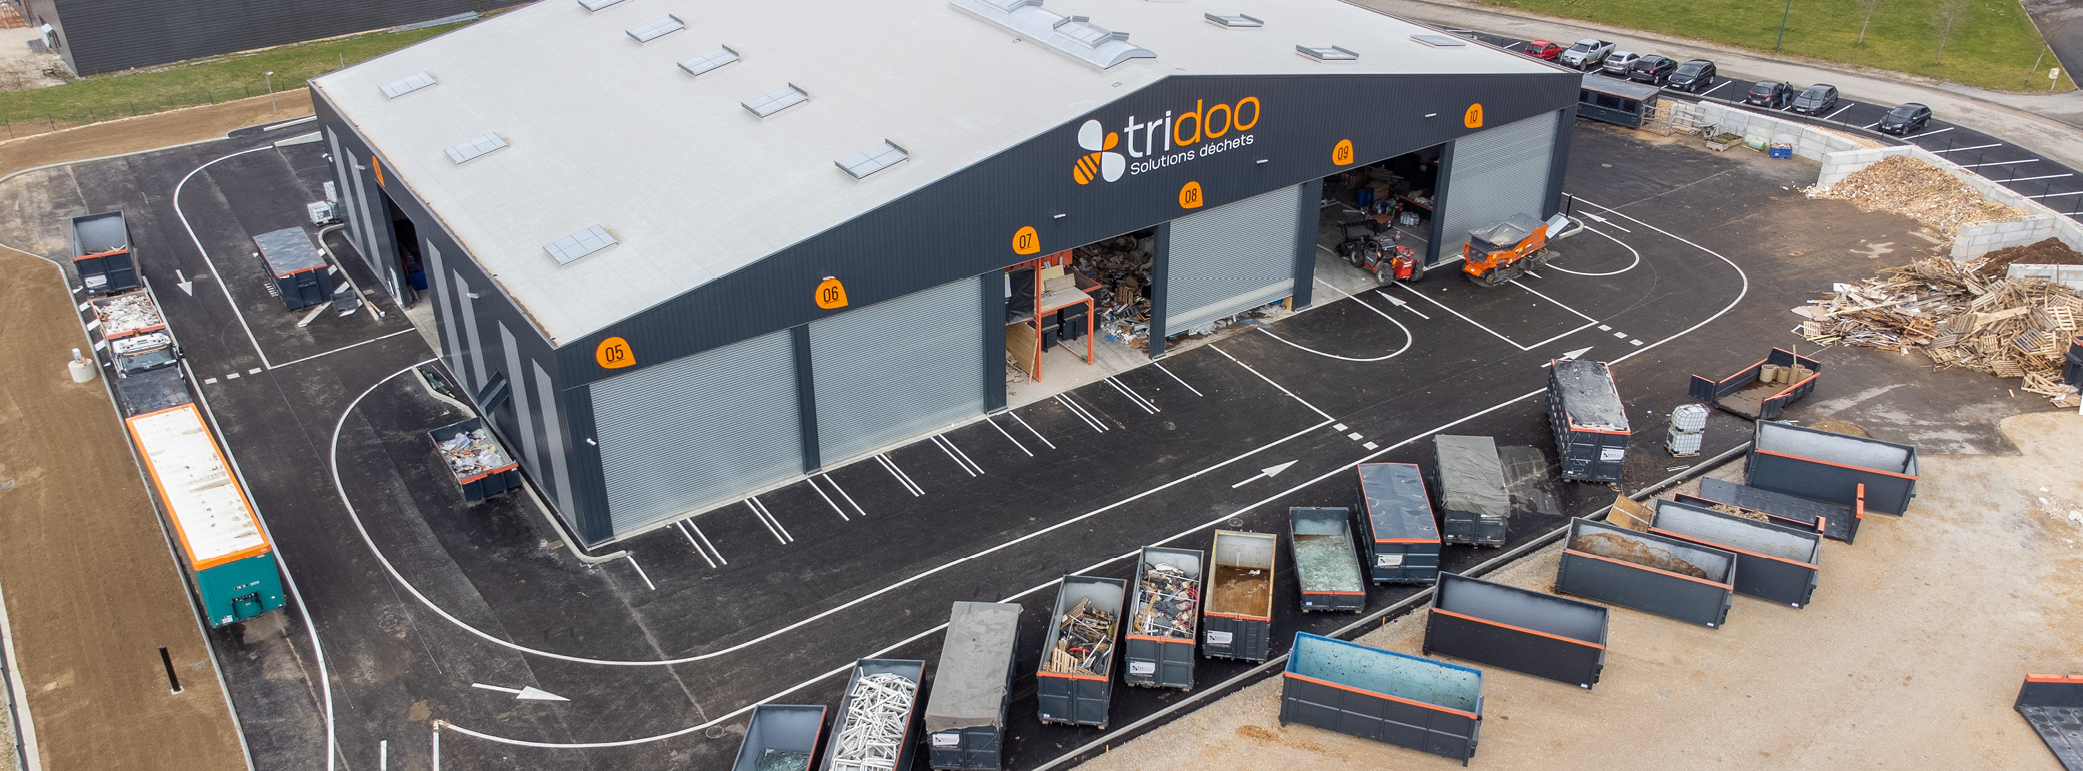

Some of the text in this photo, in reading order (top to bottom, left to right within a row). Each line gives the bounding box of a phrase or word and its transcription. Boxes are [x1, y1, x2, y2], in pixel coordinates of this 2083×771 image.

[1469, 109, 1478, 123] 10
[1124, 96, 1260, 158] tridoo
[1130, 134, 1254, 175] Solutions déchets
[1337, 145, 1349, 160] 09
[1185, 188, 1197, 203] 08
[1019, 233, 1032, 249] 07
[823, 286, 839, 303] 06
[605, 344, 624, 363] 05
